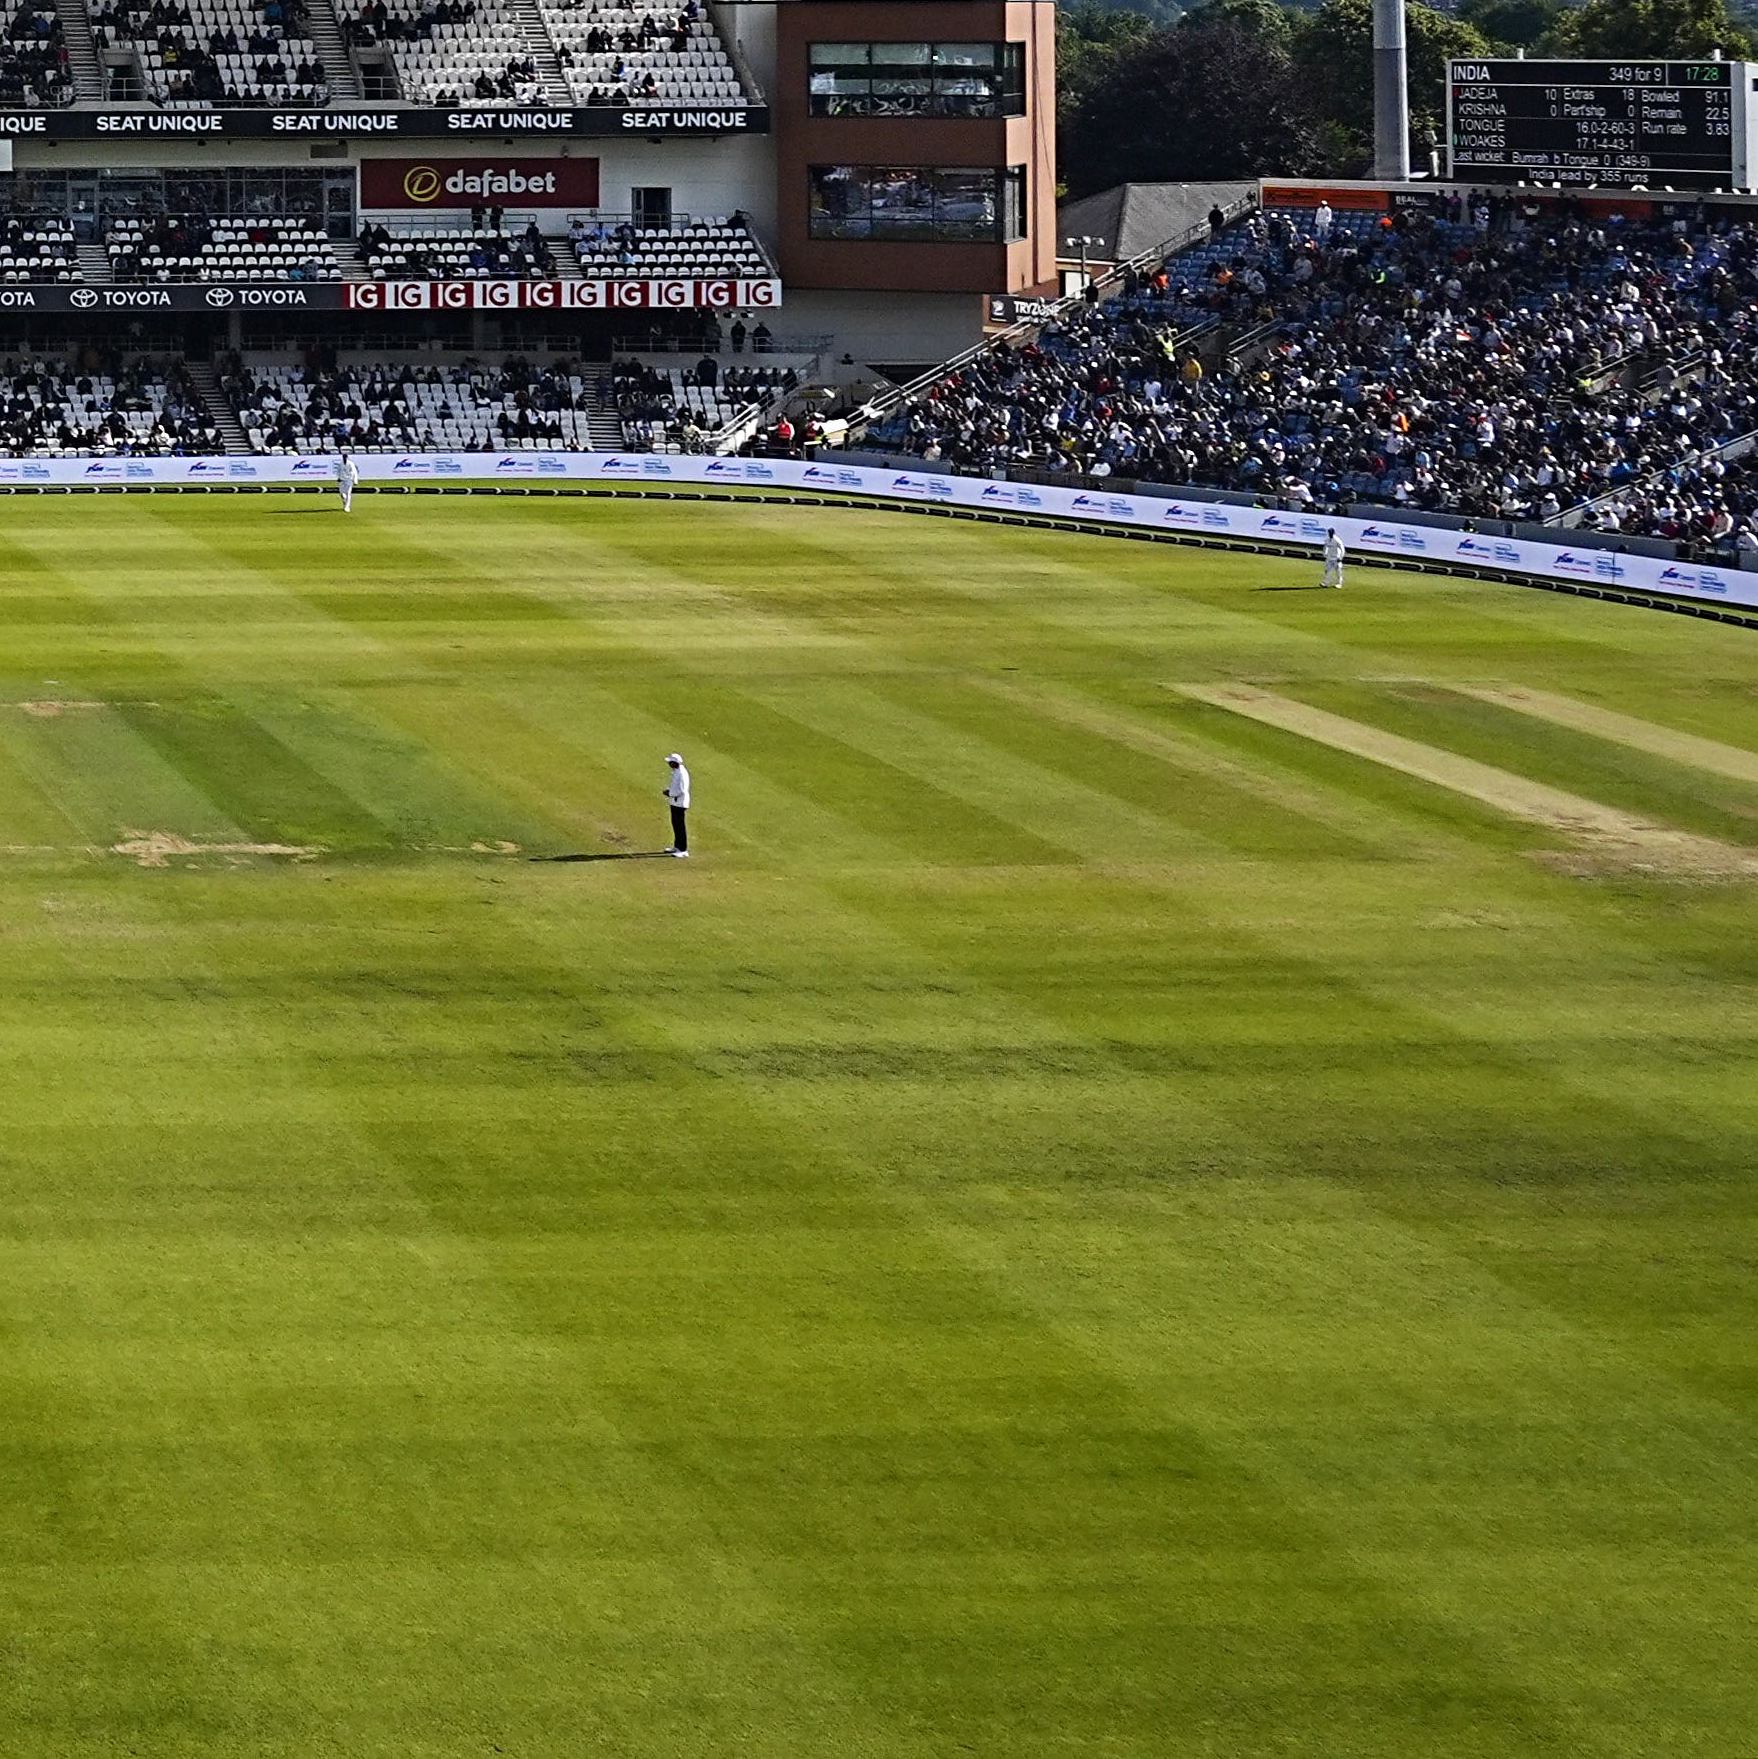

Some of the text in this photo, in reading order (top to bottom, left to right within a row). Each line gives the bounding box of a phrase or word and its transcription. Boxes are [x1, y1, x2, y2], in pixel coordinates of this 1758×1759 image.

[1453, 65, 1662, 81] INDIA 349 for 9
[1459, 87, 1557, 100] JADEJA 10
[1563, 87, 1635, 101] Extras 18
[1641, 89, 1729, 103] Bowled 91.1
[1459, 103, 1557, 117] KRISHNA 0
[1627, 104, 1635, 117] 0
[1642, 106, 1730, 120] Remain 22.5
[96, 115, 222, 132] SEAT UNIQUE
[272, 114, 398, 131] SEAT UNIQUE
[448, 113, 573, 130] SEAT UNIQUE
[622, 112, 747, 129] SEAT UNIQUE
[1459, 118, 1635, 135] TONGUE 16.0-2-60-3
[1642, 121, 1664, 135] Run
[1666, 123, 1687, 135] rate
[1459, 135, 1506, 148] WOAKES
[1453, 150, 1473, 161] Last
[1512, 151, 1549, 165] Bumrah
[1553, 152, 1560, 165] b
[1563, 153, 1599, 167] Tongue
[1603, 155, 1611, 166] 0
[446, 168, 556, 197] dafabet
[1529, 168, 1649, 183] India lead by 355 runs
[103, 291, 171, 305] TOYOTA
[239, 290, 307, 305] TOYOTA
[349, 283, 377, 307] IG
[393, 283, 421, 307] IG
[437, 283, 465, 307] IG
[481, 283, 509, 307] IG
[525, 283, 553, 307] IG
[569, 283, 597, 307] IG
[613, 283, 641, 307] IG
[657, 283, 685, 307] IG
[701, 283, 729, 307] IG
[745, 283, 773, 307] IG
